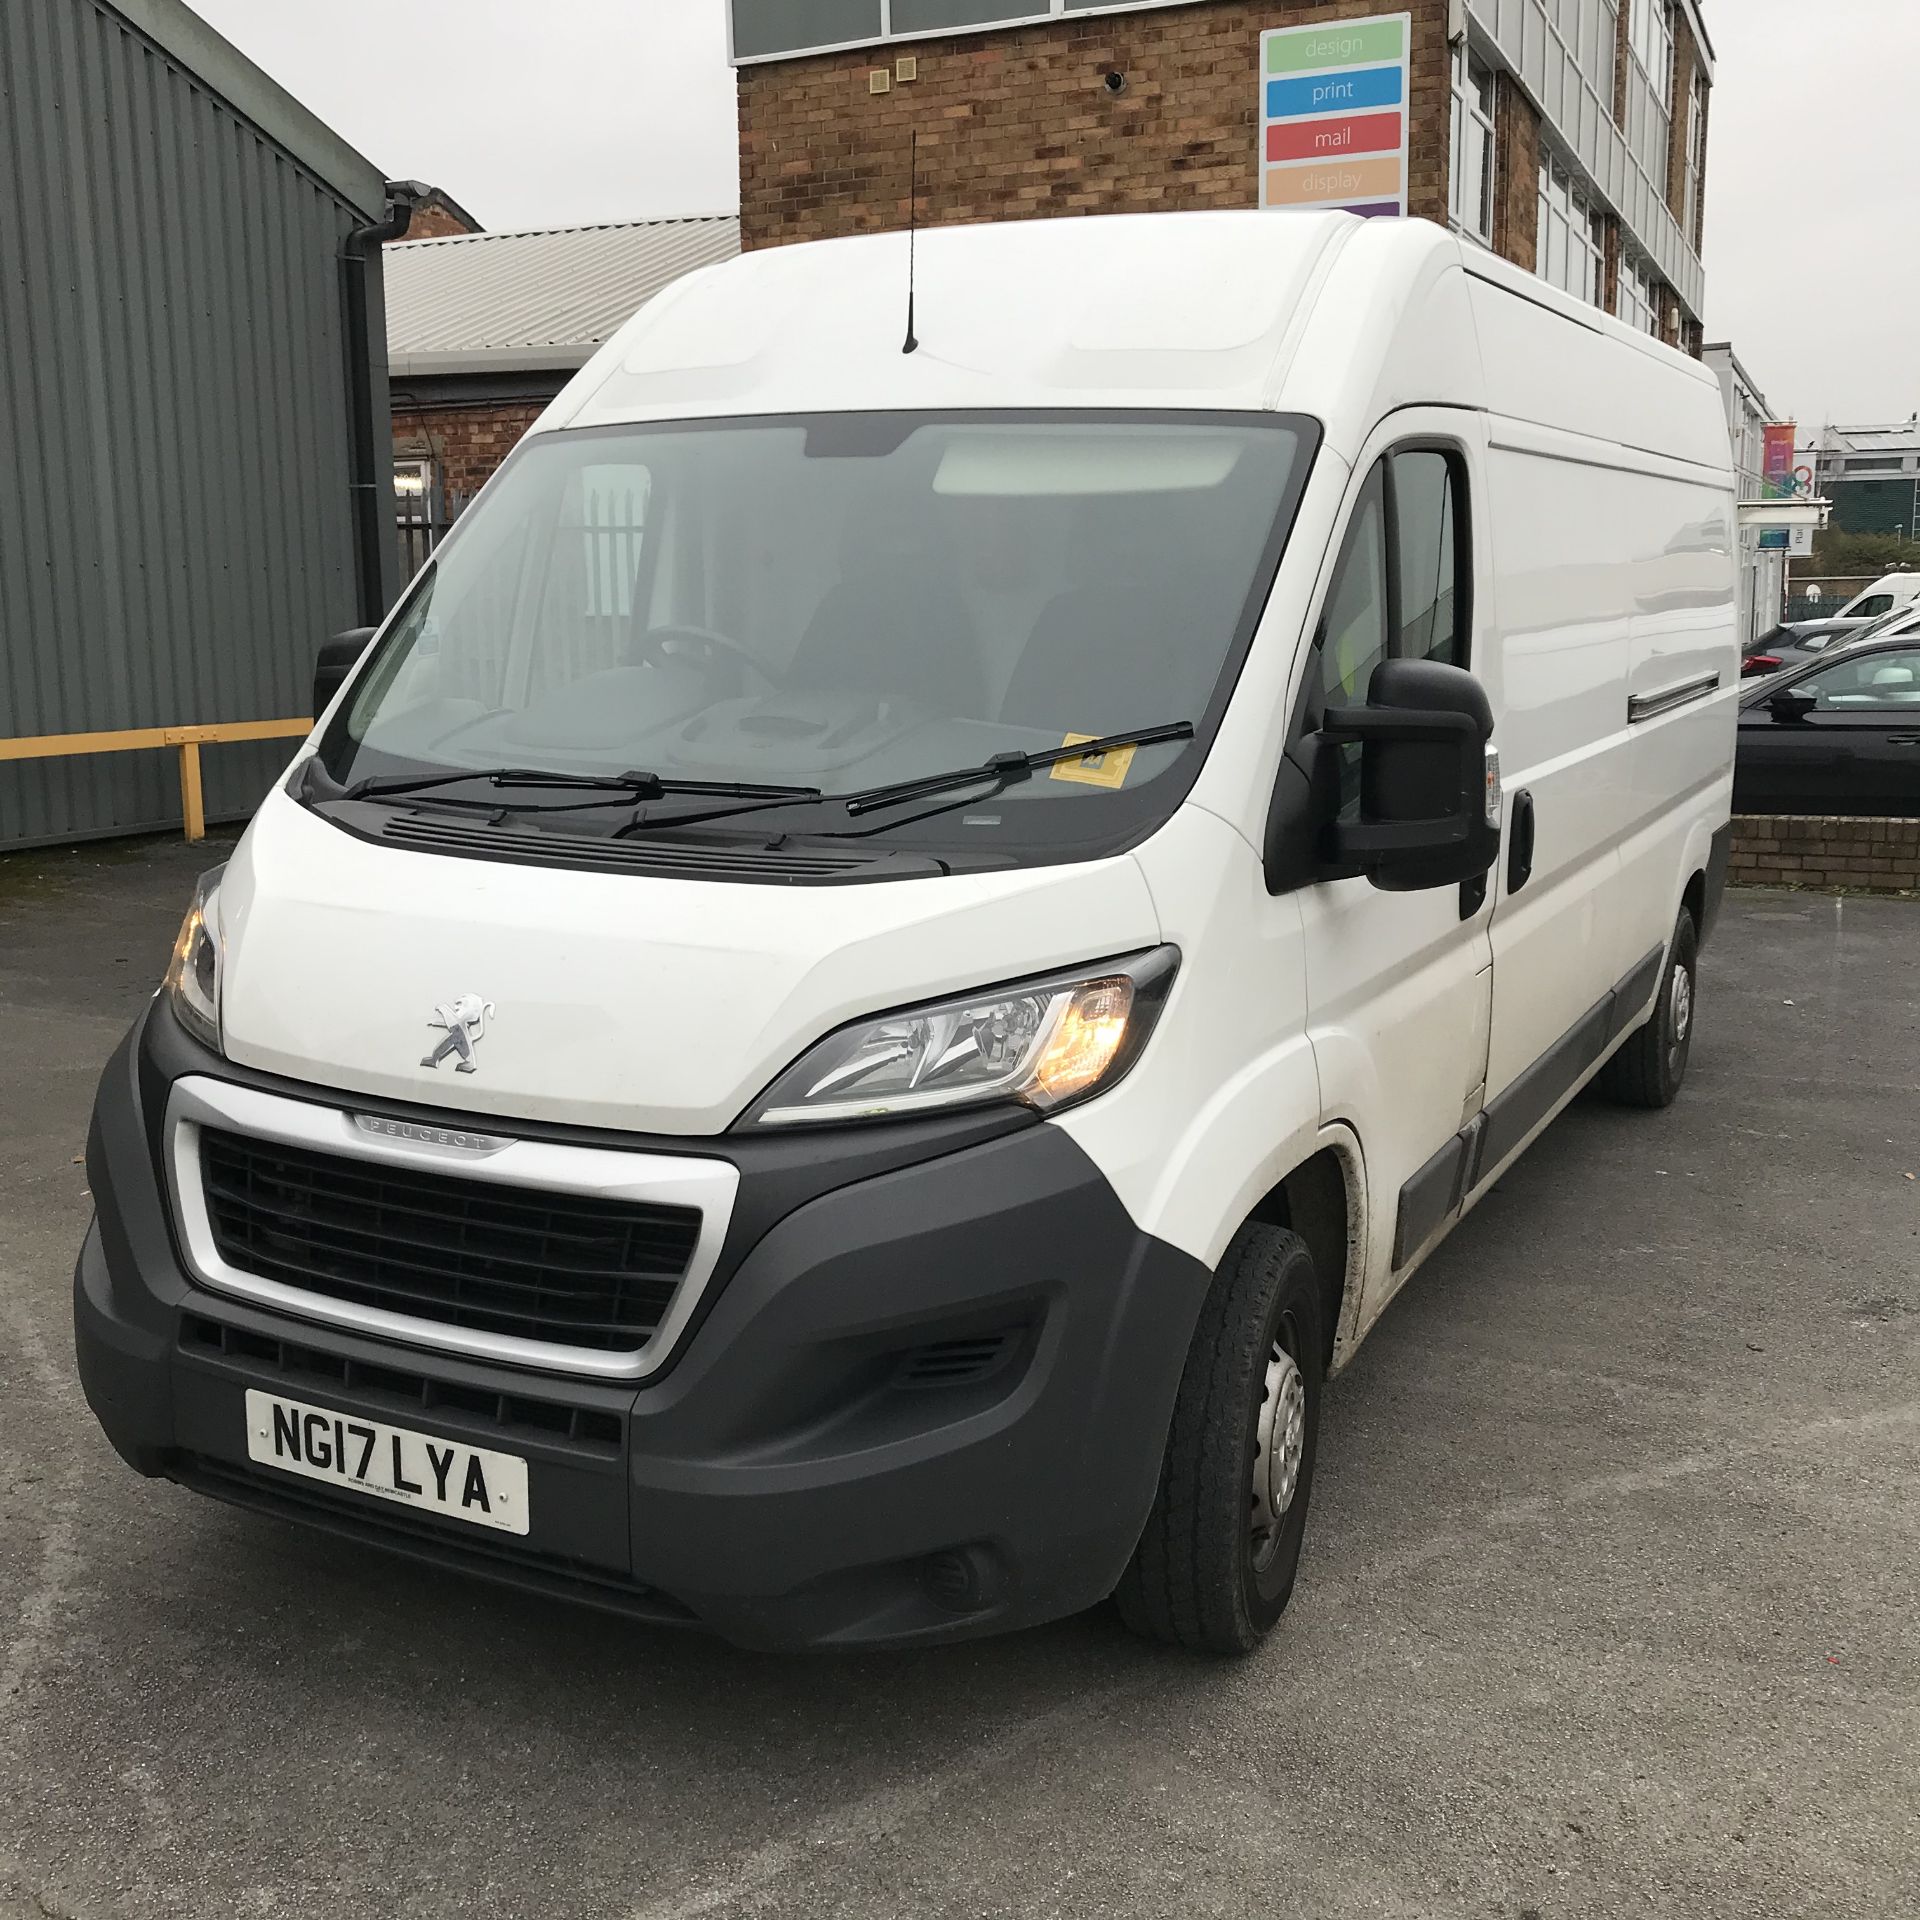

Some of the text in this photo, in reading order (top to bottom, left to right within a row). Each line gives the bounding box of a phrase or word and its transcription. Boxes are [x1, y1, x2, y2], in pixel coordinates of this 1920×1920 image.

[1305, 37, 1363, 57] design
[1312, 82, 1354, 105] print
[1315, 126, 1350, 148] mail
[1302, 171, 1362, 193] display
[370, 1119, 485, 1149] PEUGEOT
[272, 1403, 492, 1514] NG17 LYA
